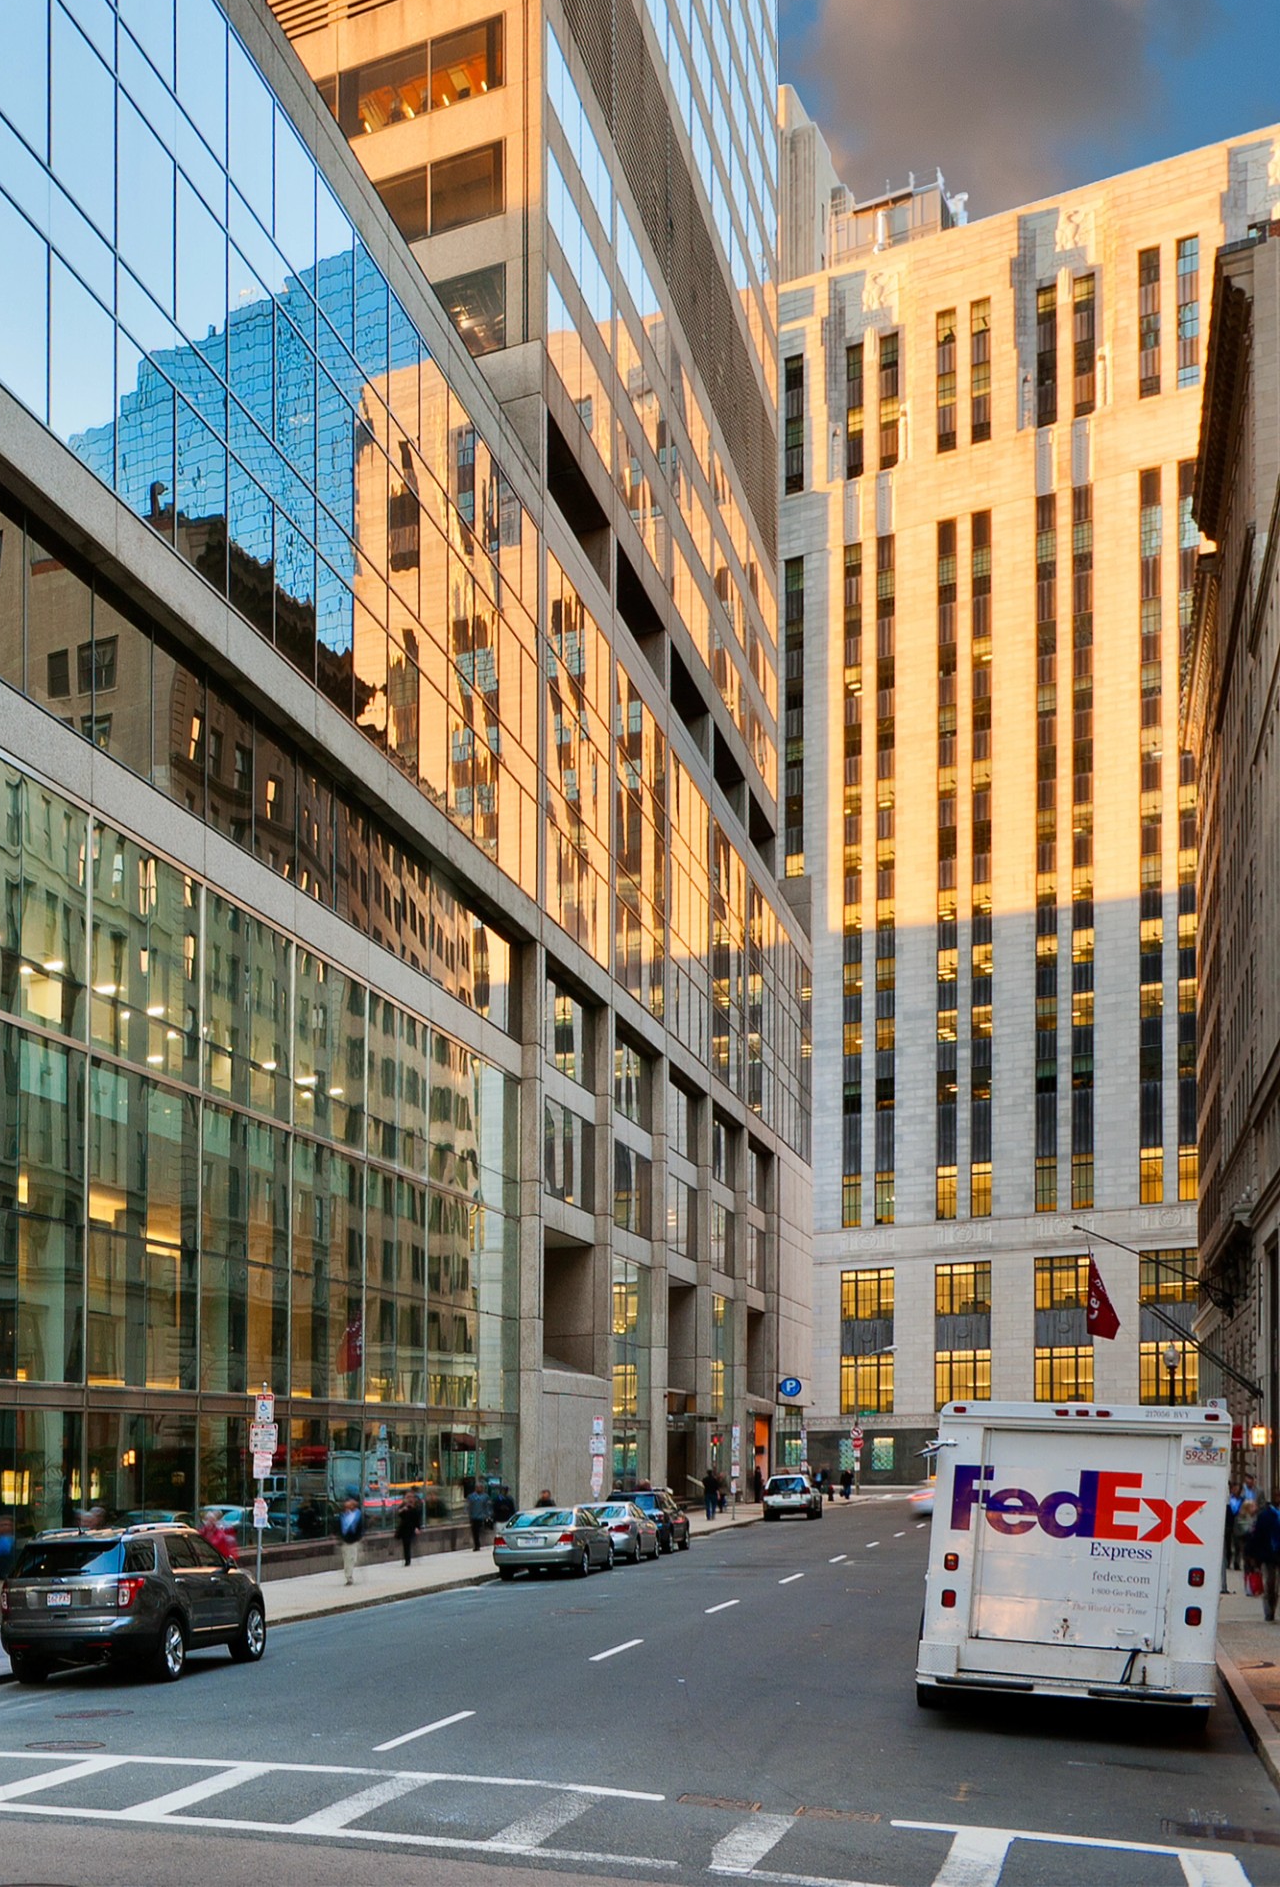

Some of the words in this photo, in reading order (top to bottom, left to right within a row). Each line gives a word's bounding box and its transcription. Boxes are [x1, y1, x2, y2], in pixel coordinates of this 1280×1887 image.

[950, 1464, 1208, 1546] FedEx
[1089, 1541, 1153, 1561] Express
[1092, 1571, 1151, 1585] fedex.com
[1072, 1603, 1086, 1611] The
[1088, 1604, 1111, 1613] World
[1113, 1606, 1124, 1614] On
[1127, 1607, 1147, 1615] Time
